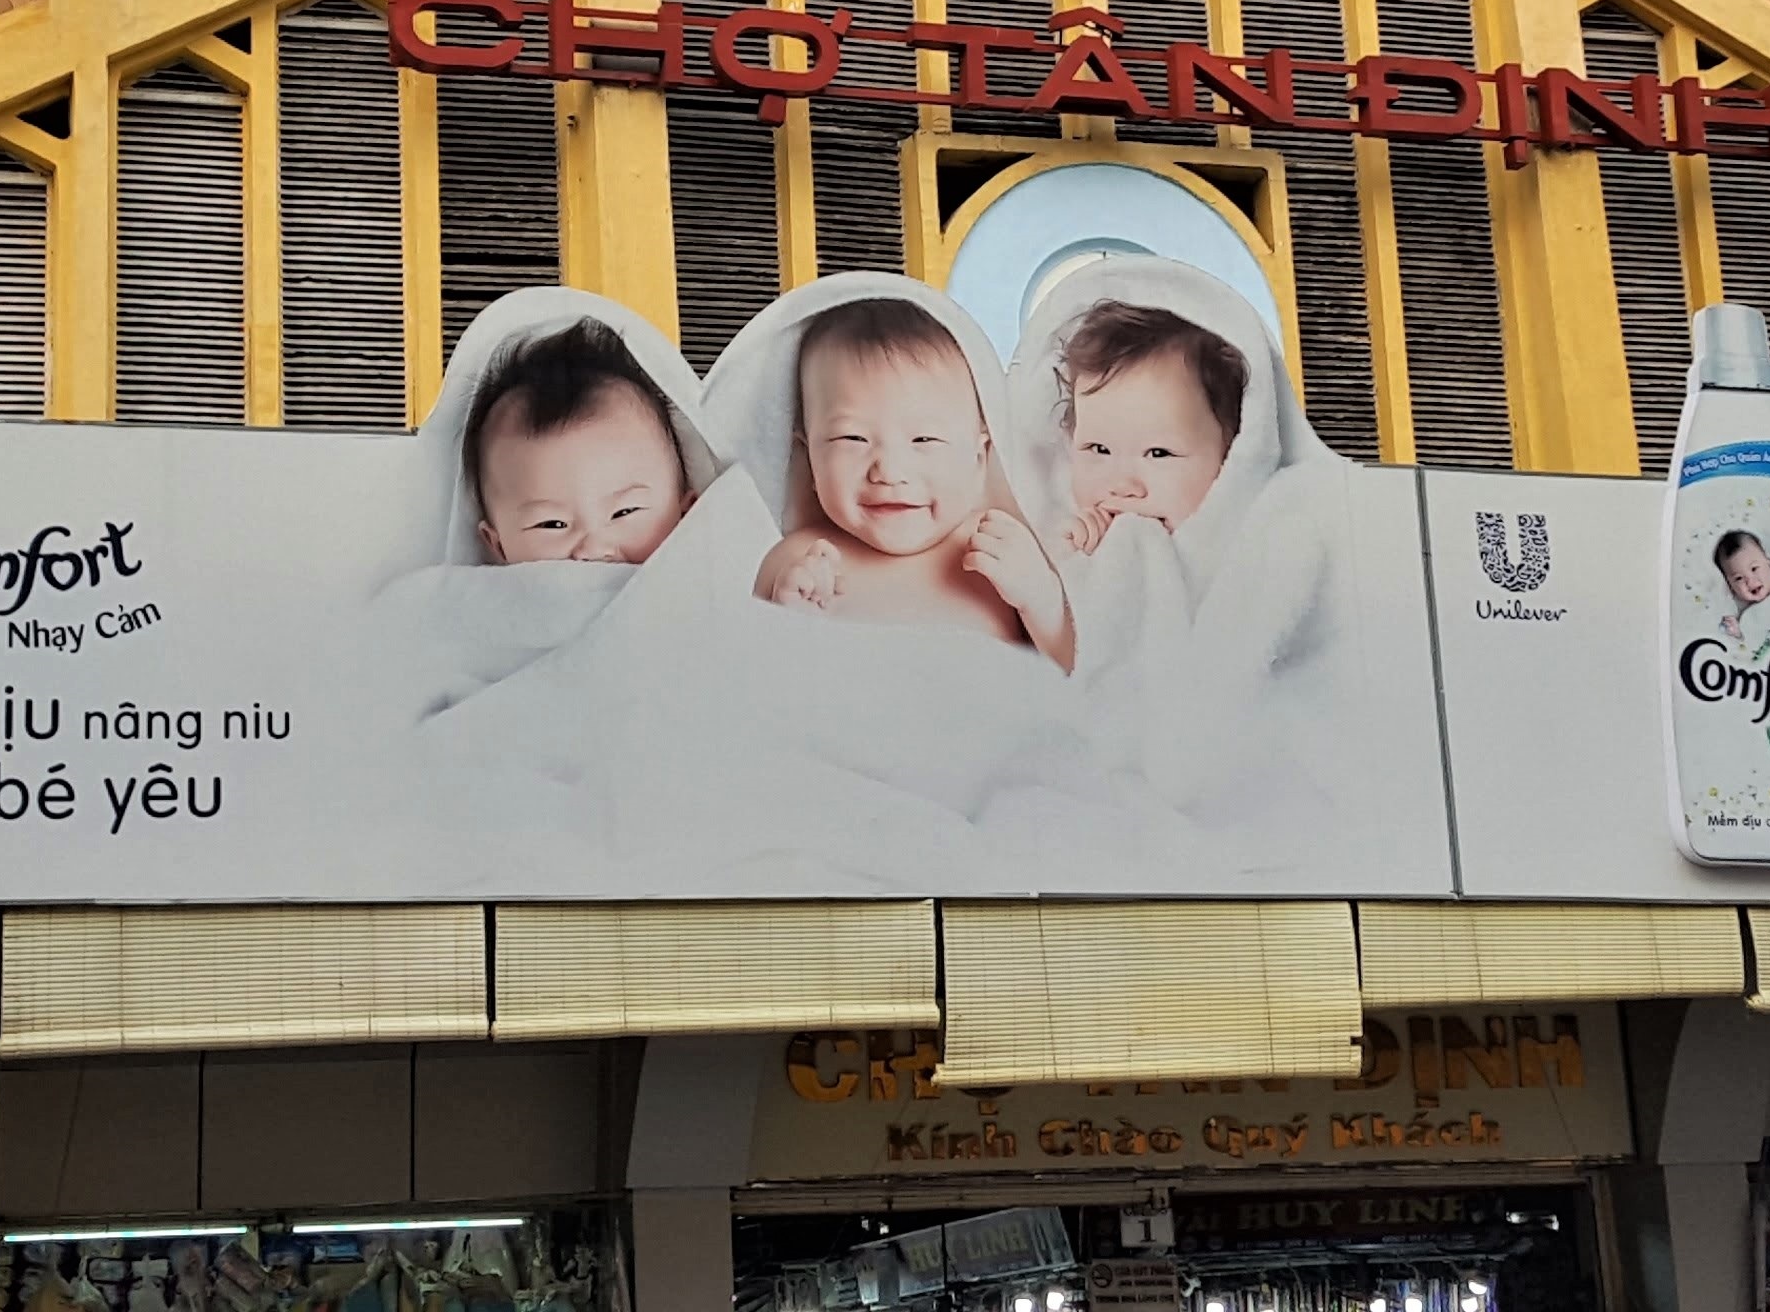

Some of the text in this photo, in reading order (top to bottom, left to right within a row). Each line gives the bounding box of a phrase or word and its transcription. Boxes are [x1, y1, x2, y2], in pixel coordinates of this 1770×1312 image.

[906, 7, 1295, 125] TÂN
[8, 620, 85, 654] Nhạy
[95, 602, 162, 638] Cảm
[1476, 599, 1568, 621] Unilever
[85, 702, 202, 750] nâng
[223, 702, 291, 740] niu
[103, 763, 222, 835] yêu
[886, 1110, 1502, 1161] Kính Chào Quý Khách
